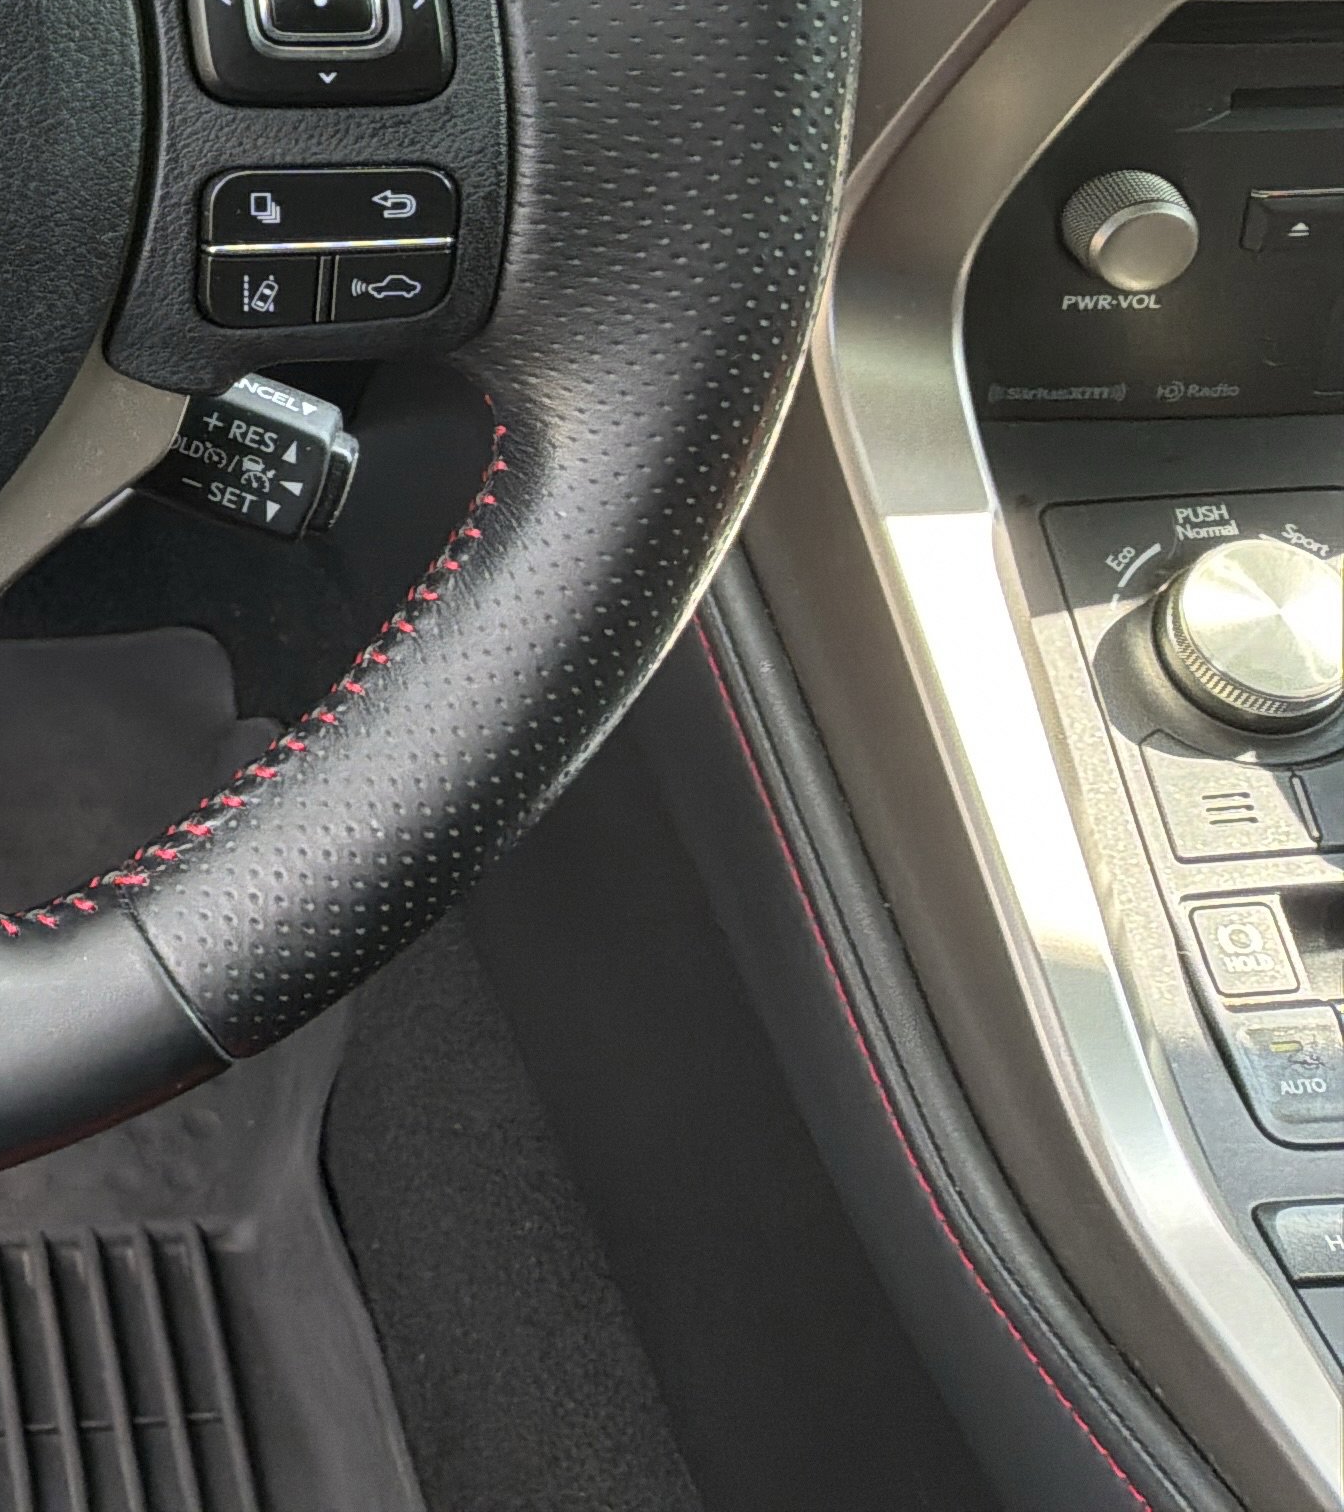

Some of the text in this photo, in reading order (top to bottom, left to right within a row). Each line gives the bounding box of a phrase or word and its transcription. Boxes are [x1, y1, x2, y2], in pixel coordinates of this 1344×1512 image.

[238, 377, 300, 412] NCEL
[1187, 383, 1240, 397] Radio
[228, 420, 278, 453] RES
[208, 481, 259, 513] SET
[1175, 504, 1228, 524] PUSH
[1176, 520, 1239, 540] Normal
[1281, 523, 1330, 556] Sport
[1105, 546, 1135, 573] Eco
[1223, 953, 1274, 972] HOLD
[1280, 1078, 1327, 1095] AUTO
